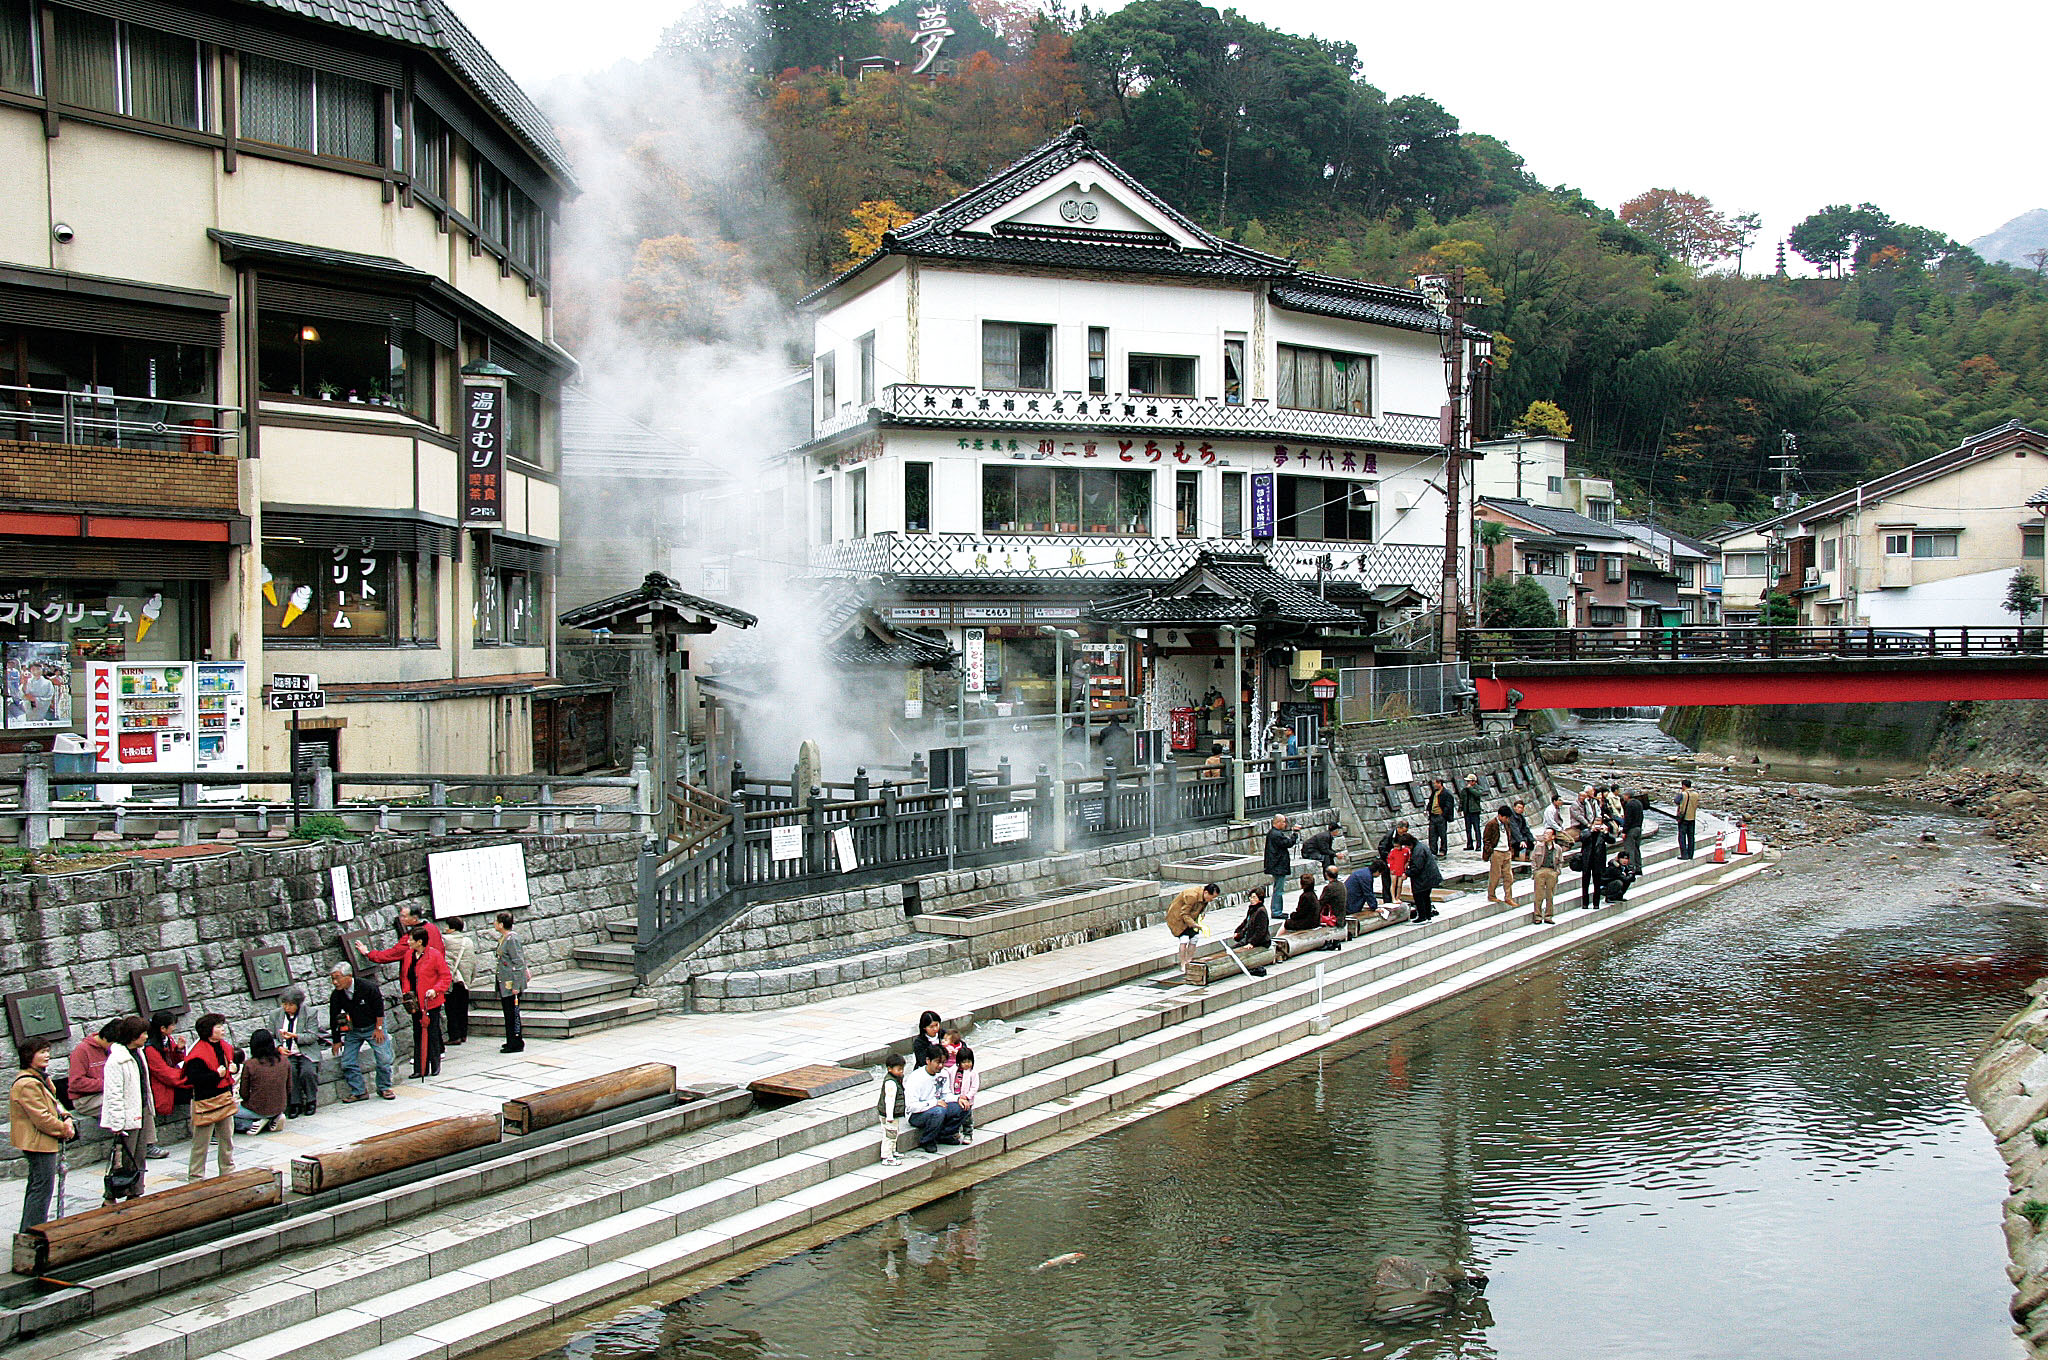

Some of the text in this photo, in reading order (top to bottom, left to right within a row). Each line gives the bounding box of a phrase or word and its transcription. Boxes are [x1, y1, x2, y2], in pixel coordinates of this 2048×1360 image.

[910, 4, 955, 75] 夢
[471, 392, 494, 468] 湯けむり
[1118, 440, 1216, 465] とちもち
[1273, 444, 1378, 474] 夢千代茶屋
[332, 543, 352, 628] クリーム
[95, 668, 110, 763] KIRIN
